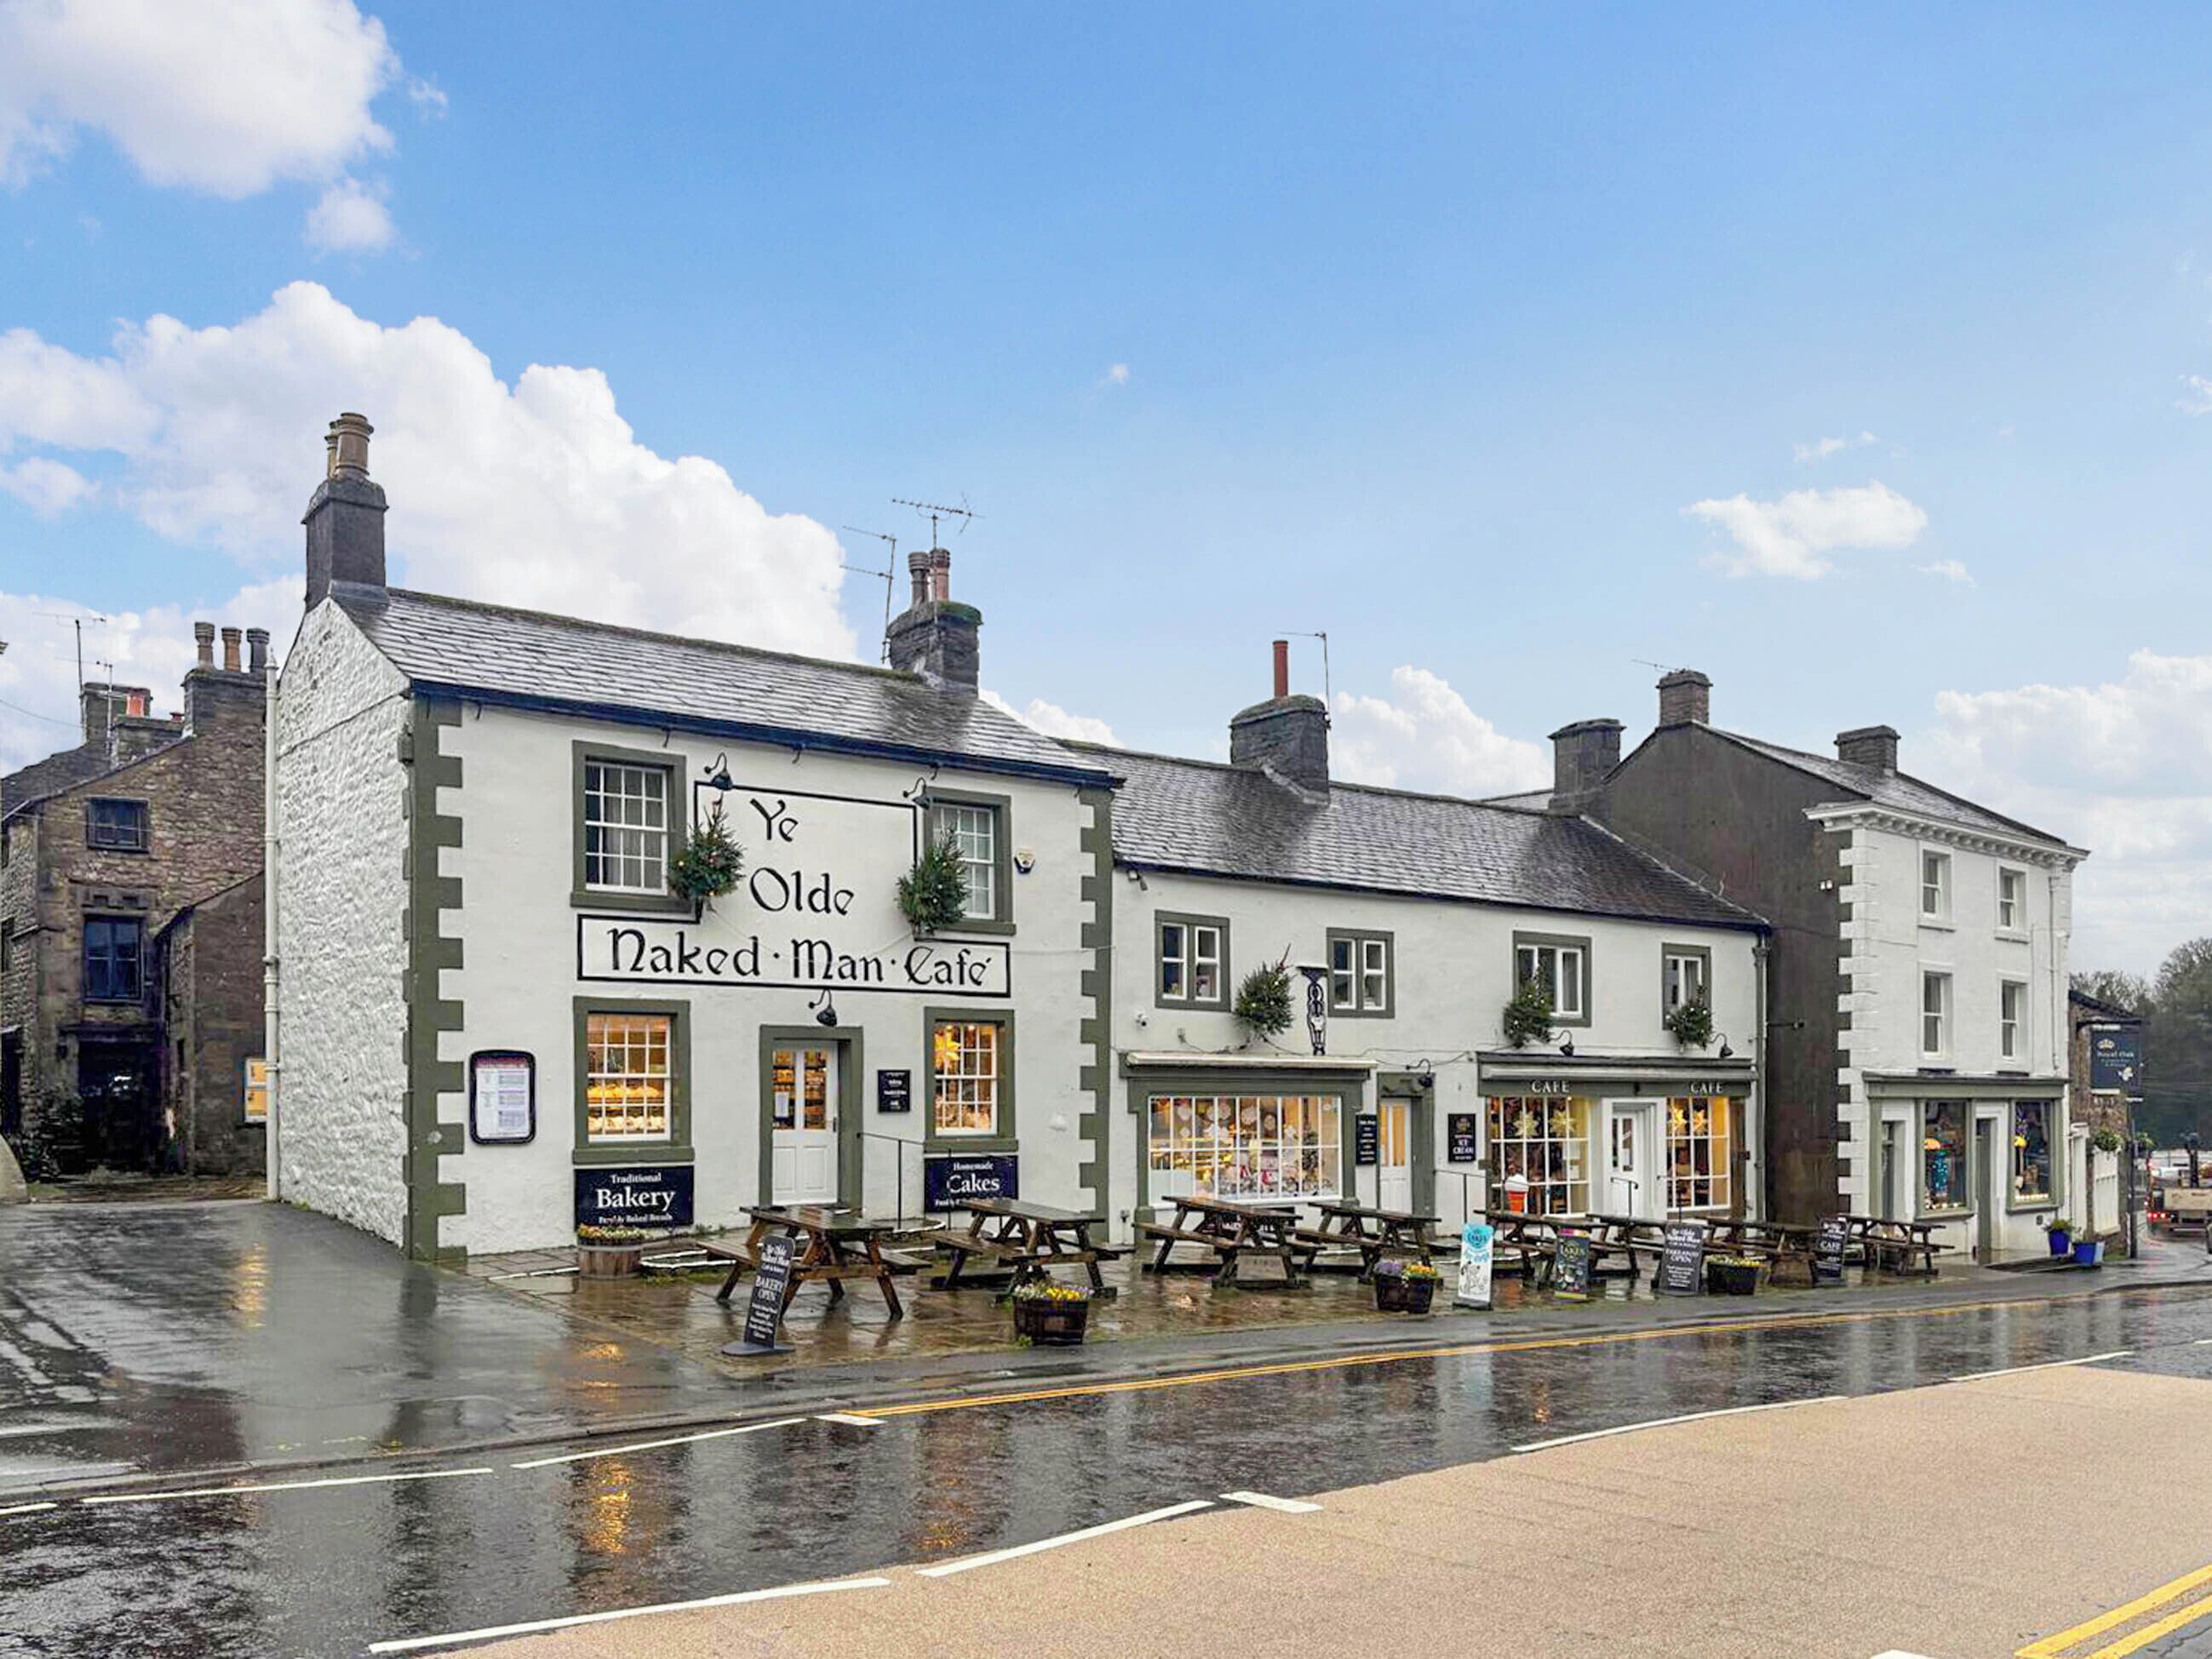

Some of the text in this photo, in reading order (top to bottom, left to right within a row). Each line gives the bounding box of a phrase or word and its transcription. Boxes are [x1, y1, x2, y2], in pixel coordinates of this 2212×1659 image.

[749, 799, 799, 842] Ye
[749, 867, 855, 916] Olde
[607, 928, 992, 987] Naked Man Café
[1532, 1080, 1569, 1093] CAFE
[1690, 1082, 1722, 1094] CAFE
[610, 1172, 662, 1184] Traditional
[946, 1173, 1000, 1193] Cakes
[596, 1186, 675, 1212] Bakery
